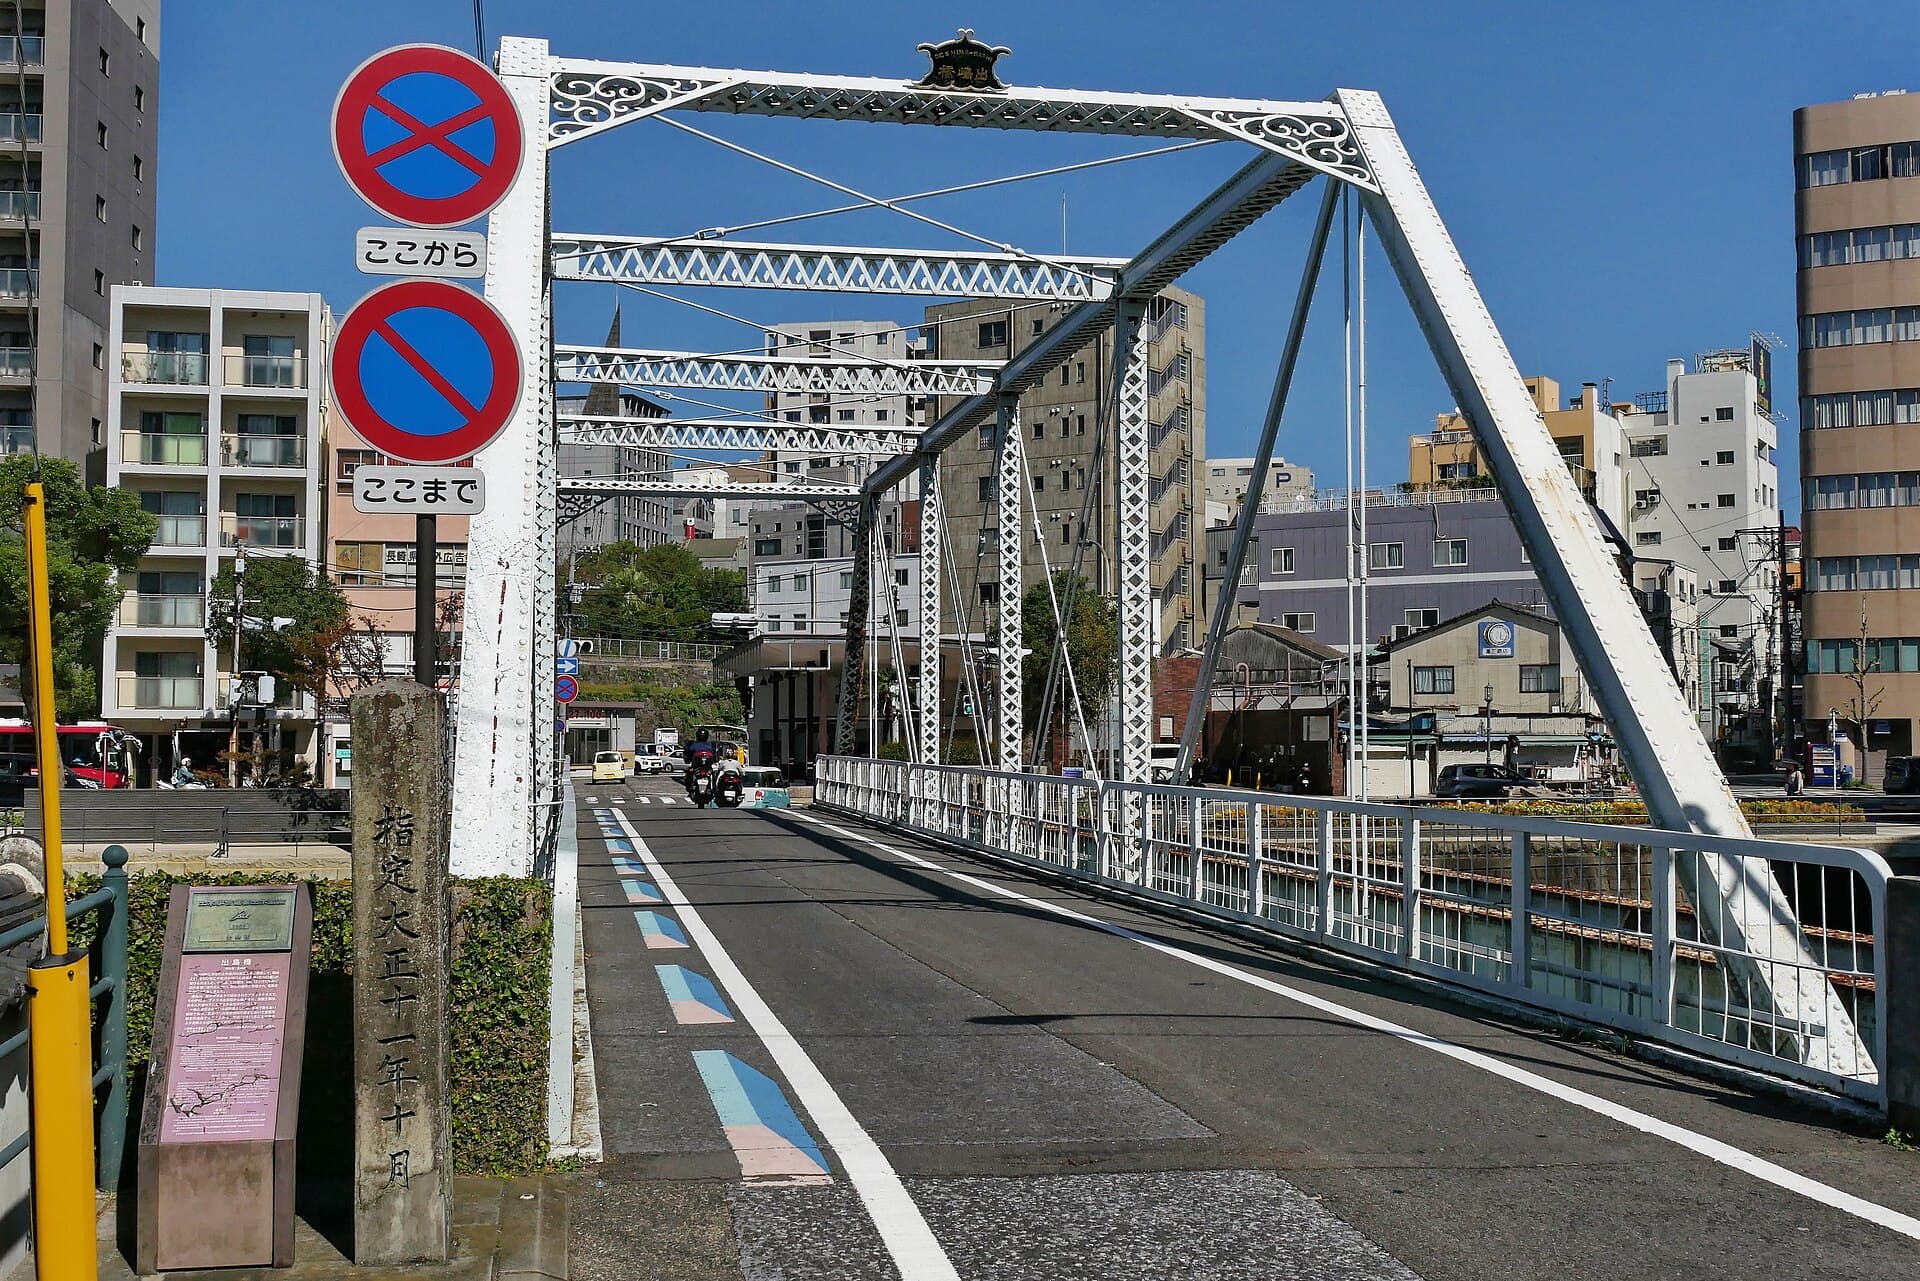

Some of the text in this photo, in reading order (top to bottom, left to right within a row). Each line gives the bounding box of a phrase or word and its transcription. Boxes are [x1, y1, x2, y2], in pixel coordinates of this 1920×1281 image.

[365, 239, 478, 267] ここから
[362, 478, 478, 504] ここまで
[1276, 472, 1292, 488] P
[374, 803, 419, 1190] 指定大正十一年十月
